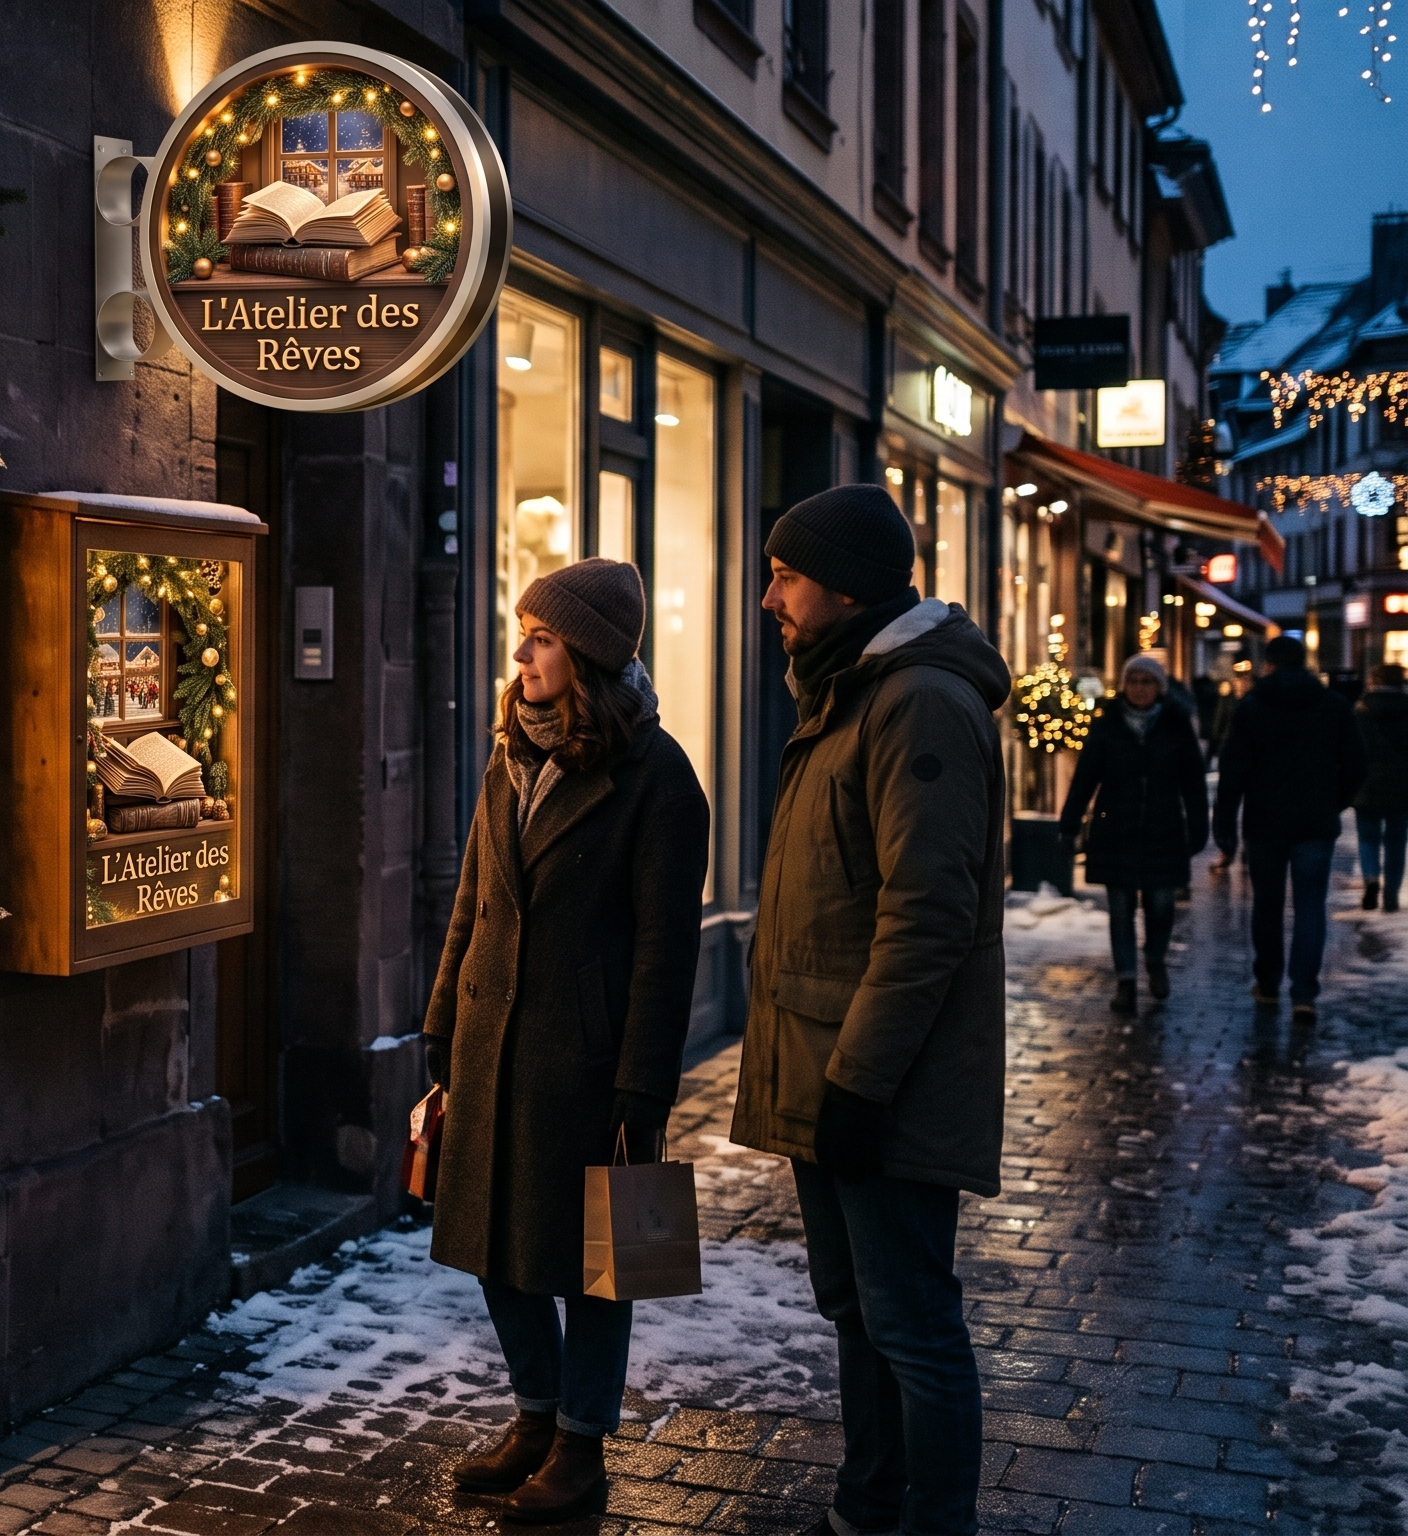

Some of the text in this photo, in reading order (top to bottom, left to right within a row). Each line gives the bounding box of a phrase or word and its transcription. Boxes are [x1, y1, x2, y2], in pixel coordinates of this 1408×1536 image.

[201, 294, 419, 331] L'Atelier des
[256, 336, 361, 371] Rêves
[100, 839, 230, 885] L'Atelier des
[135, 880, 199, 914] Rêves
